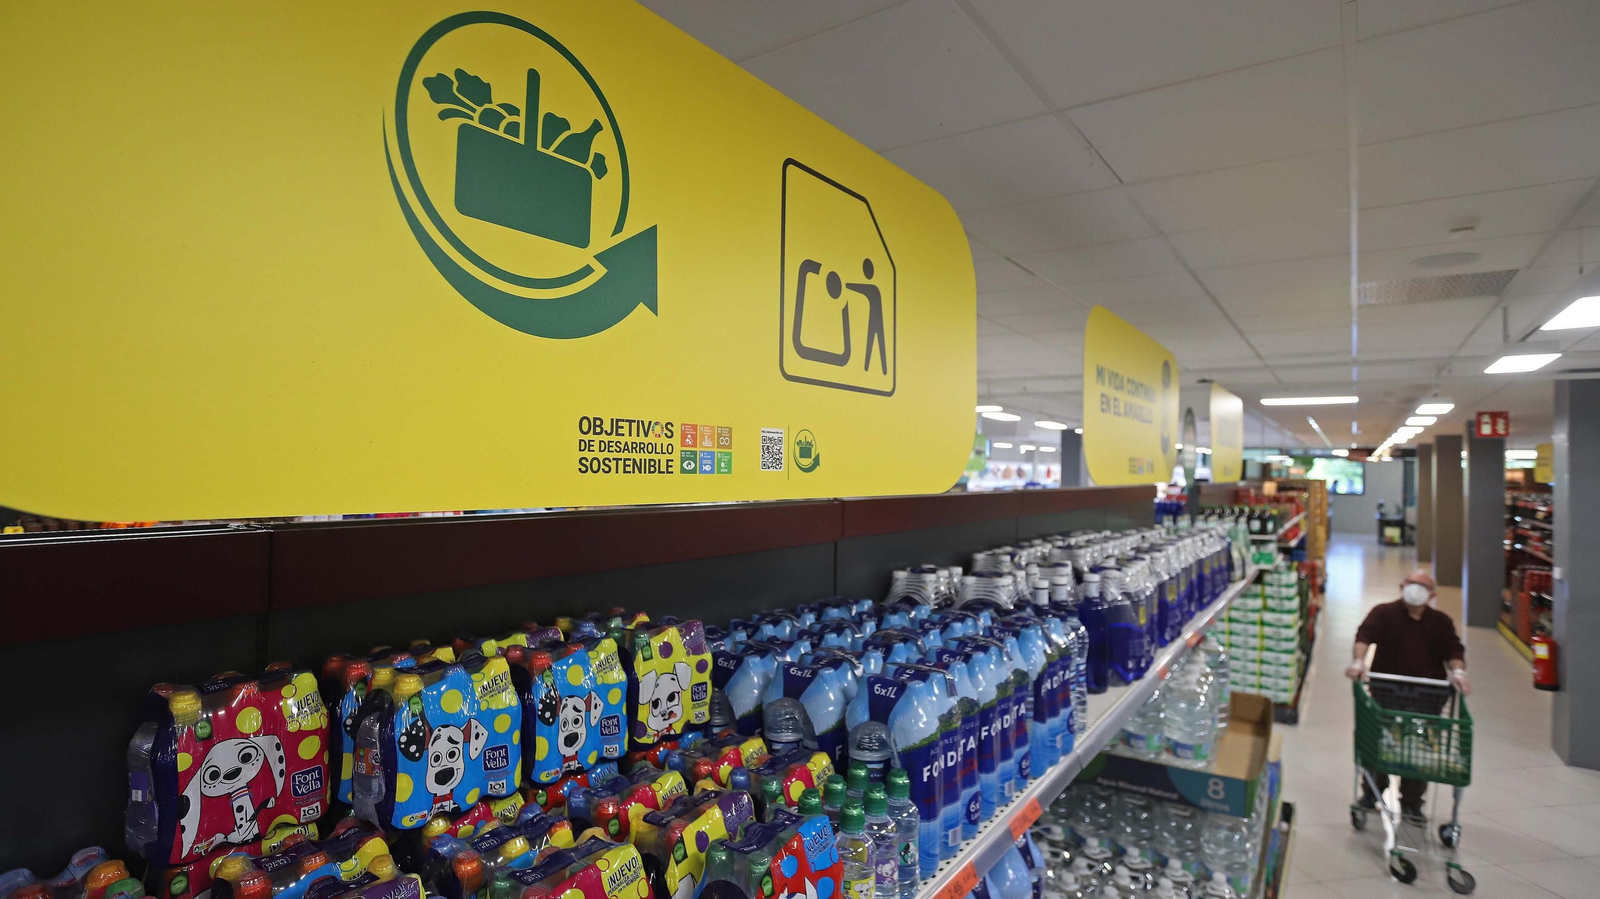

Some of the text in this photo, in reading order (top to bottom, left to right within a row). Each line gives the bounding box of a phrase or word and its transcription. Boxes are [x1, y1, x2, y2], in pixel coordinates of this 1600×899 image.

[1101, 393, 1111, 415] EN
[1113, 397, 1121, 417] EL
[578, 416, 674, 439] OBJETIVOS
[578, 439, 595, 453] DE
[598, 440, 674, 455] DESARROLLO
[578, 456, 674, 474] SOSTENIBLE
[717, 657, 736, 670] 6x1L
[789, 666, 812, 678] 6x1L
[692, 684, 707, 695] Font
[873, 683, 897, 698] 6x1L
[602, 717, 618, 728] Font
[602, 724, 620, 735] Vella
[485, 748, 506, 760] Font
[486, 757, 508, 769] Vella
[295, 769, 320, 785] Font
[295, 780, 320, 796] Vella
[488, 782, 505, 790] 101
[1207, 778, 1226, 800] 8
[302, 806, 320, 816] 101
